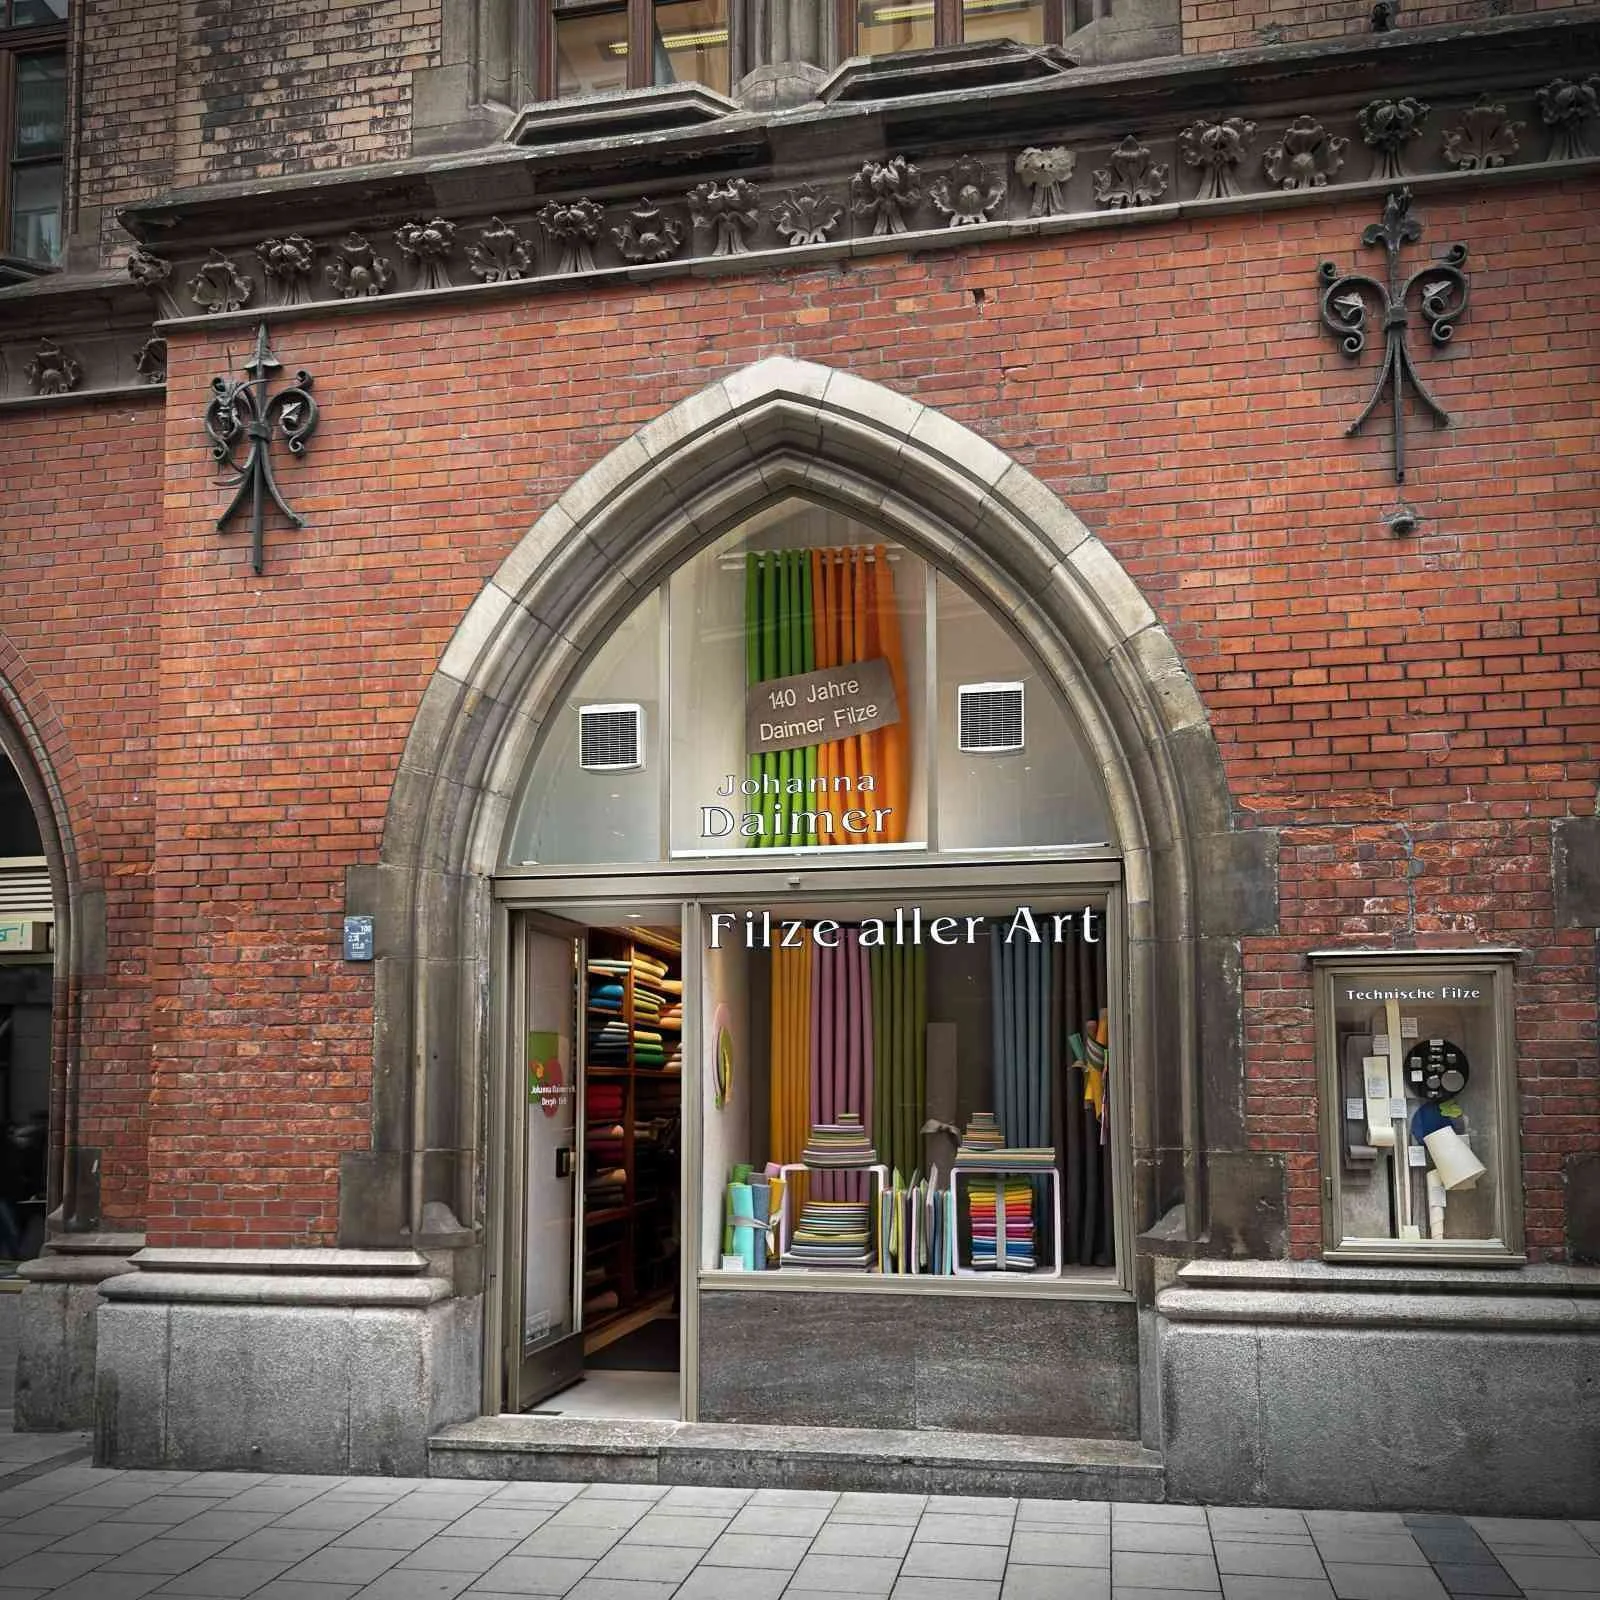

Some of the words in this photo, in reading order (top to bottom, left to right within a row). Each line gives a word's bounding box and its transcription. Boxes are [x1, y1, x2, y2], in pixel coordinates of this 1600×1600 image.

[768, 688, 797, 709] 140
[807, 678, 859, 703] Jahre
[760, 715, 825, 742] Daimer
[834, 703, 878, 728] Filze
[717, 773, 876, 797] Johanna
[700, 803, 893, 838] Daimer
[709, 911, 840, 948] Filze
[858, 905, 985, 947] aller
[1004, 905, 1100, 944] Art
[1345, 988, 1435, 1000] Technische
[1442, 987, 1481, 999] Filze
